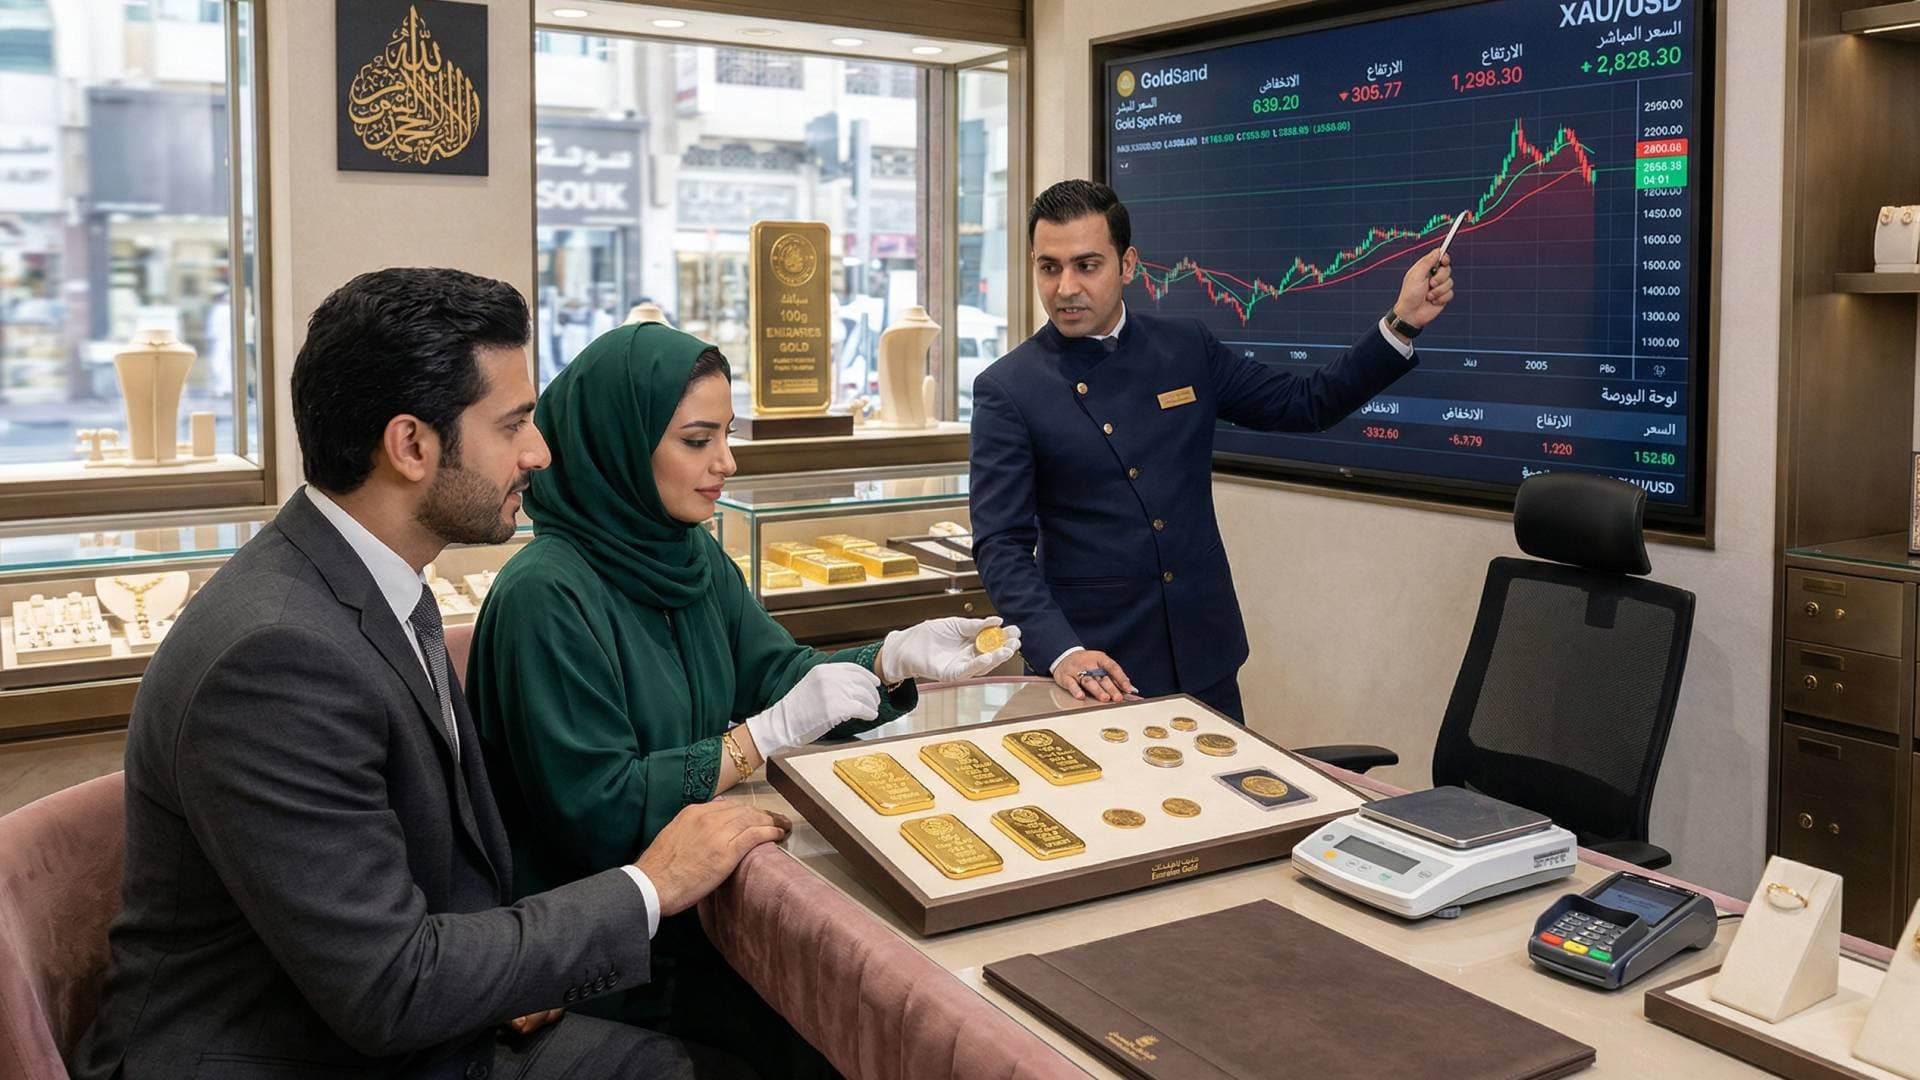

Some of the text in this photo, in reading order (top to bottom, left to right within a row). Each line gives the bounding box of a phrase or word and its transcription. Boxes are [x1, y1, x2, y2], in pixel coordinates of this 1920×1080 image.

[1559, 0, 1682, 28] XAU/USD
[1596, 20, 1682, 49] السعر المباشر
[1481, 43, 1523, 65] الارتفاع
[1597, 46, 1682, 76] 2,828.30
[1140, 63, 1208, 90] GoldSand
[1367, 60, 1403, 81] الارتفاع
[1451, 66, 1523, 92] 1,298.30
[1259, 74, 1300, 94] الانخفاض
[1352, 81, 1402, 102] 305.77
[1253, 94, 1300, 114] 639.20
[1115, 112, 1182, 130] Gold Spot Price
[1643, 125, 1683, 137] 2200.00
[536, 181, 628, 210] SOUK
[1641, 286, 1681, 297] 1400.00
[1641, 311, 1681, 322] 1300.00
[779, 341, 810, 353] GOLD
[1525, 360, 1548, 370] 2005
[1601, 387, 1678, 408] لوحة البورصة
[1536, 413, 1572, 429] الارتفاع
[1643, 424, 1676, 437] السعر
